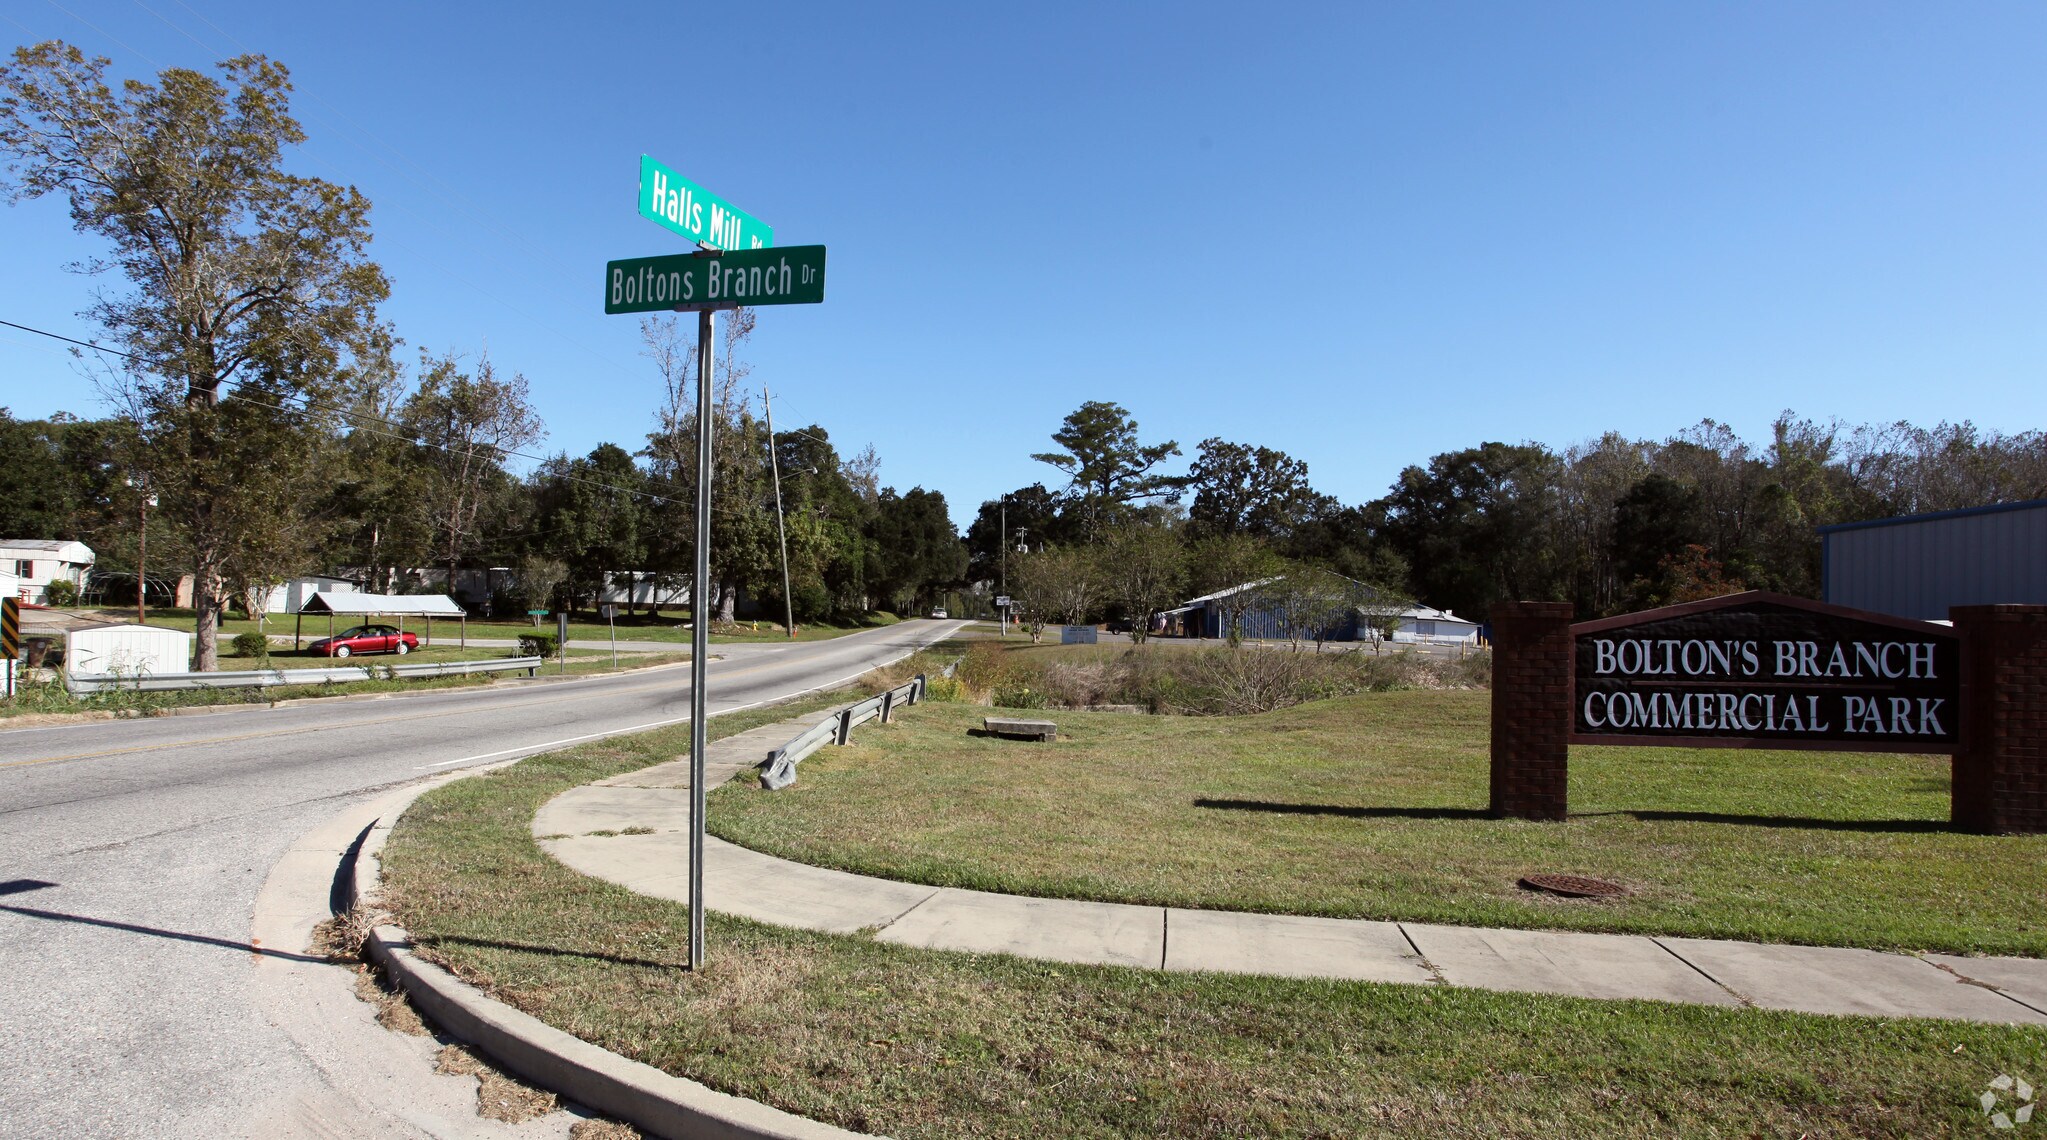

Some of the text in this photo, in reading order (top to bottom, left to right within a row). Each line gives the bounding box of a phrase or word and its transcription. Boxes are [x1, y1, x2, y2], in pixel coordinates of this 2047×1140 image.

[652, 170, 702, 234] Halls
[709, 203, 741, 250] Mill
[612, 256, 816, 305] Boltons Branch Dr
[1594, 639, 1937, 678] BOLTON'S BRANCH
[1584, 691, 1946, 735] COMMERCIAL PARK
